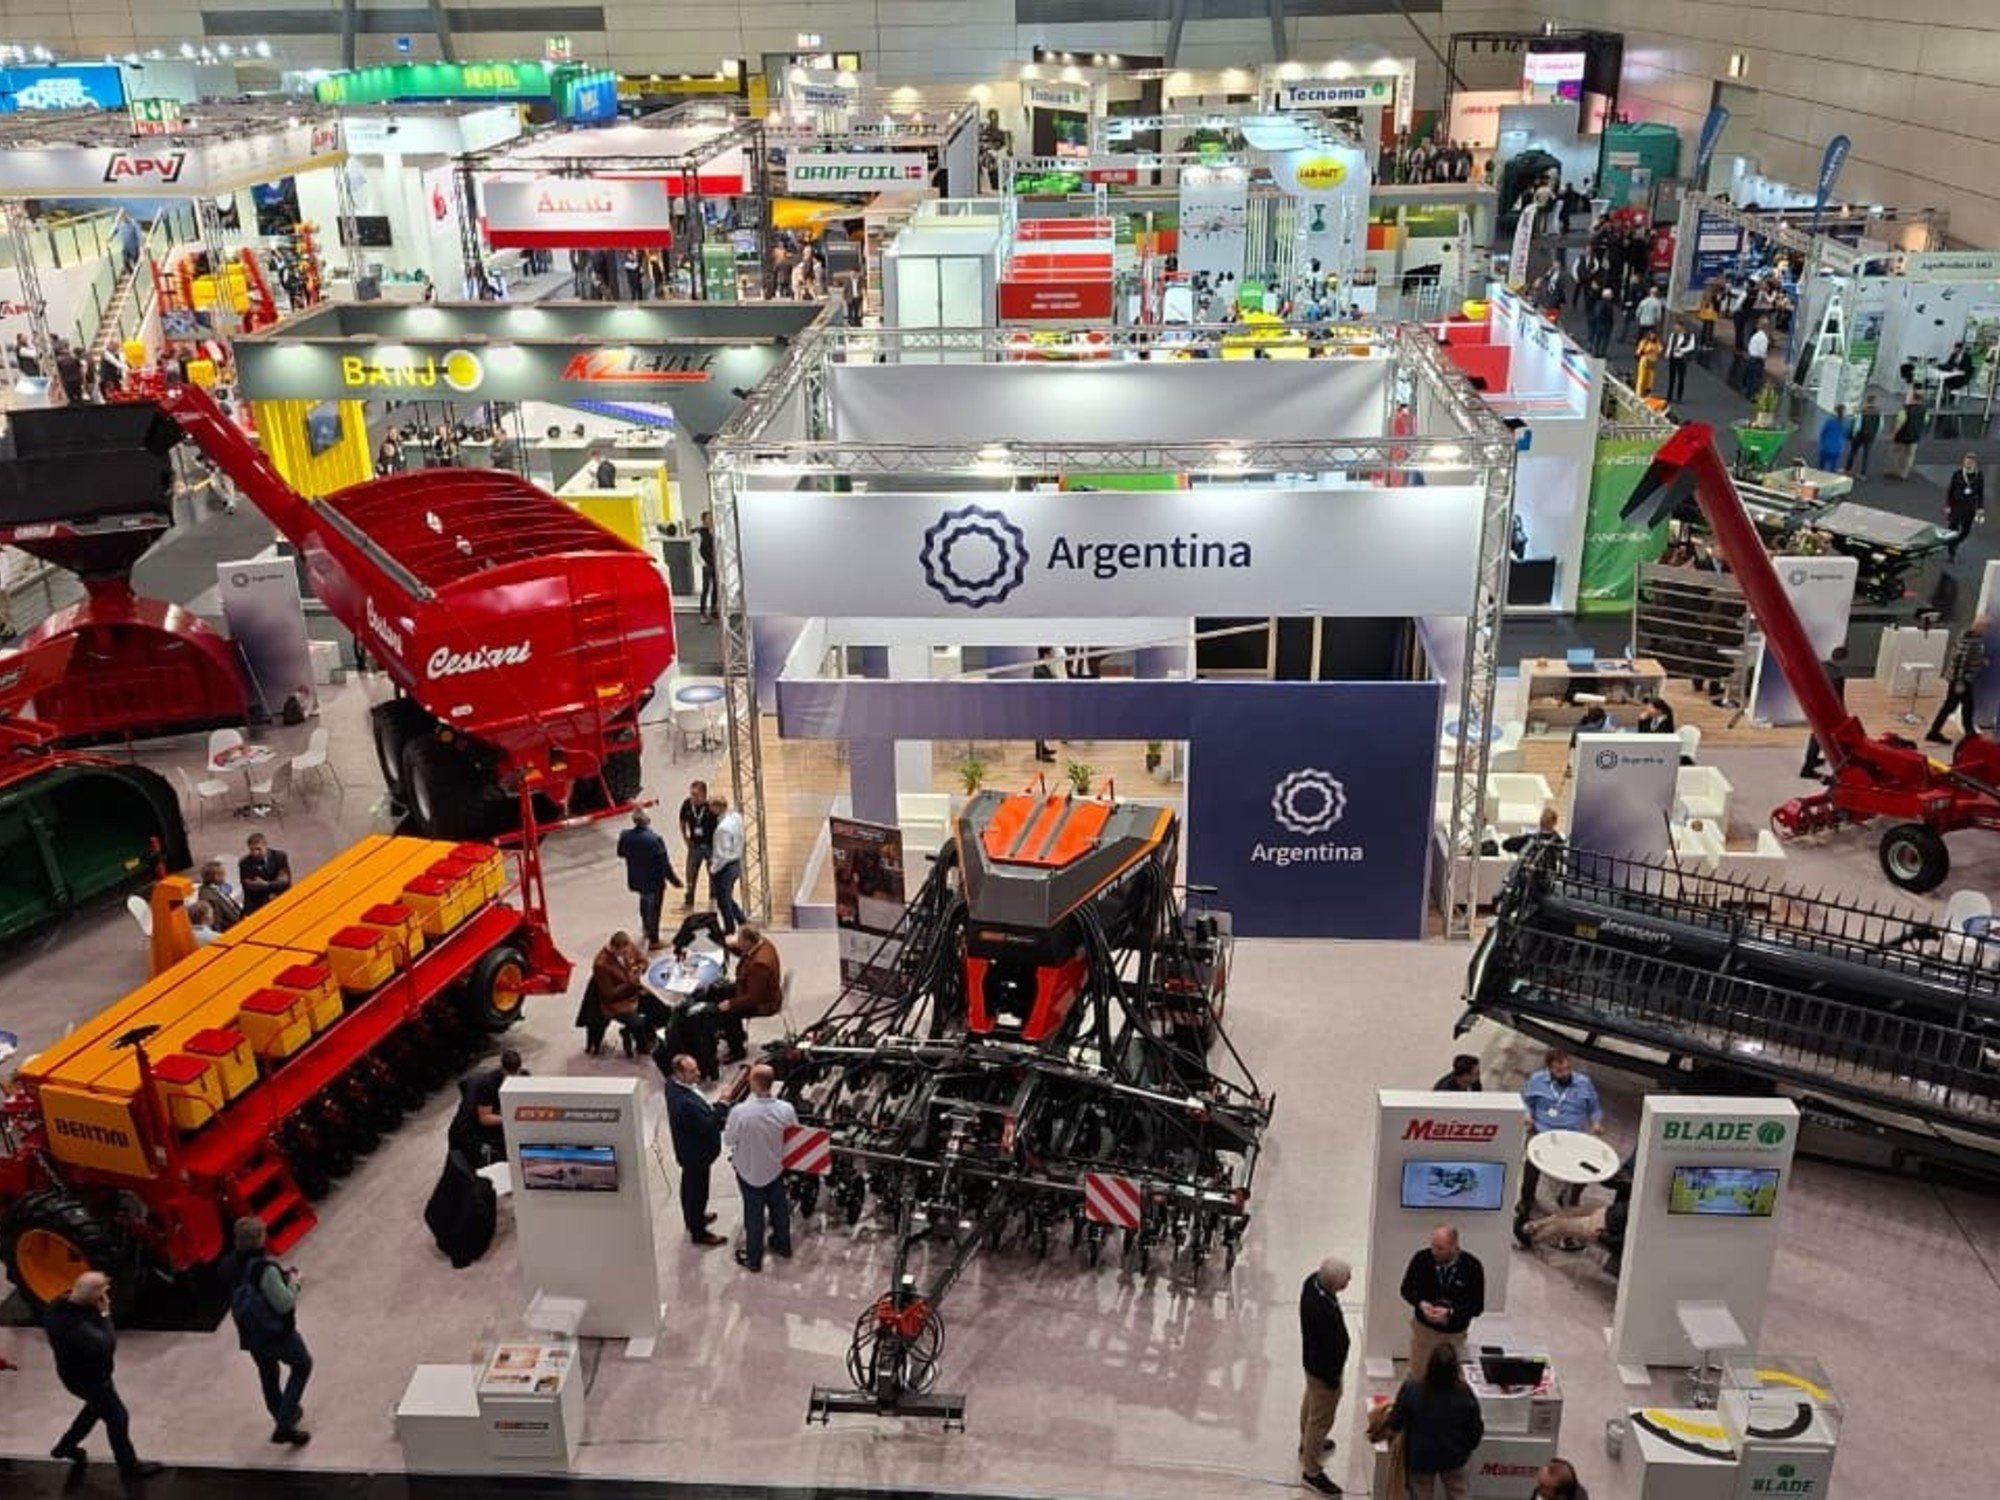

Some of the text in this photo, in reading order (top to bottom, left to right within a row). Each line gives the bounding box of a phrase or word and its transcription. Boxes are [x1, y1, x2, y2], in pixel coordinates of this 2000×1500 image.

[1288, 87, 1366, 101] Tecnoma
[794, 165, 904, 181] DANFOIL
[1047, 533, 1254, 580] Argentina
[1250, 840, 1364, 866] Argentina
[1663, 1121, 1754, 1141] BLADE
[1752, 1478, 1816, 1493] BLADE
